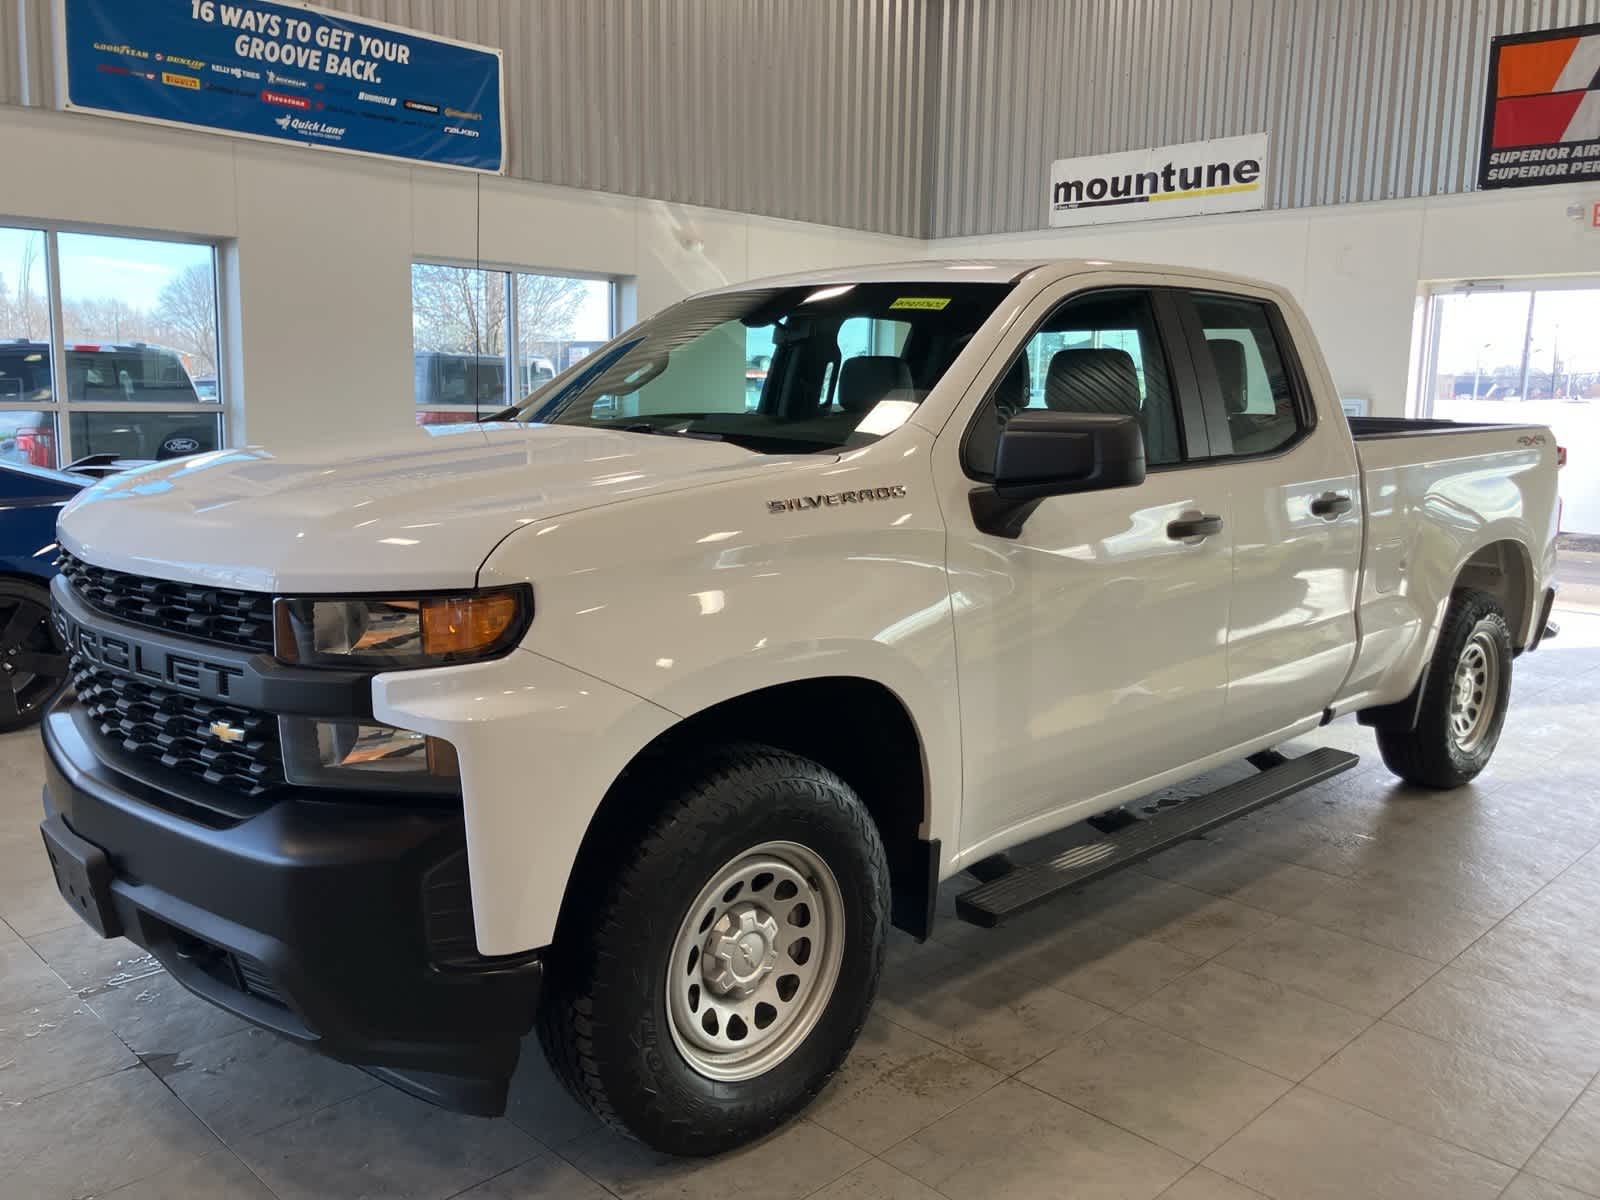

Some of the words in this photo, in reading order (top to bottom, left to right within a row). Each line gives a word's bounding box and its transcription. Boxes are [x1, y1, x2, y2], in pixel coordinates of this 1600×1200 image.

[191, 0, 213, 22] 16
[220, 4, 280, 37] WAYS
[285, 18, 311, 43] TO
[315, 26, 354, 52] GET
[359, 35, 410, 64] YOUR
[93, 42, 149, 58] GOODYEAR
[234, 35, 322, 71] GROOVE
[325, 53, 382, 84] BACK.
[291, 118, 320, 132] Quick
[320, 123, 345, 136] Lane
[1489, 147, 1568, 165] SUPERIOR
[1053, 159, 1261, 204] mountune
[1487, 163, 1568, 181] SUPERIOR
[766, 485, 907, 514] SILVERADO
